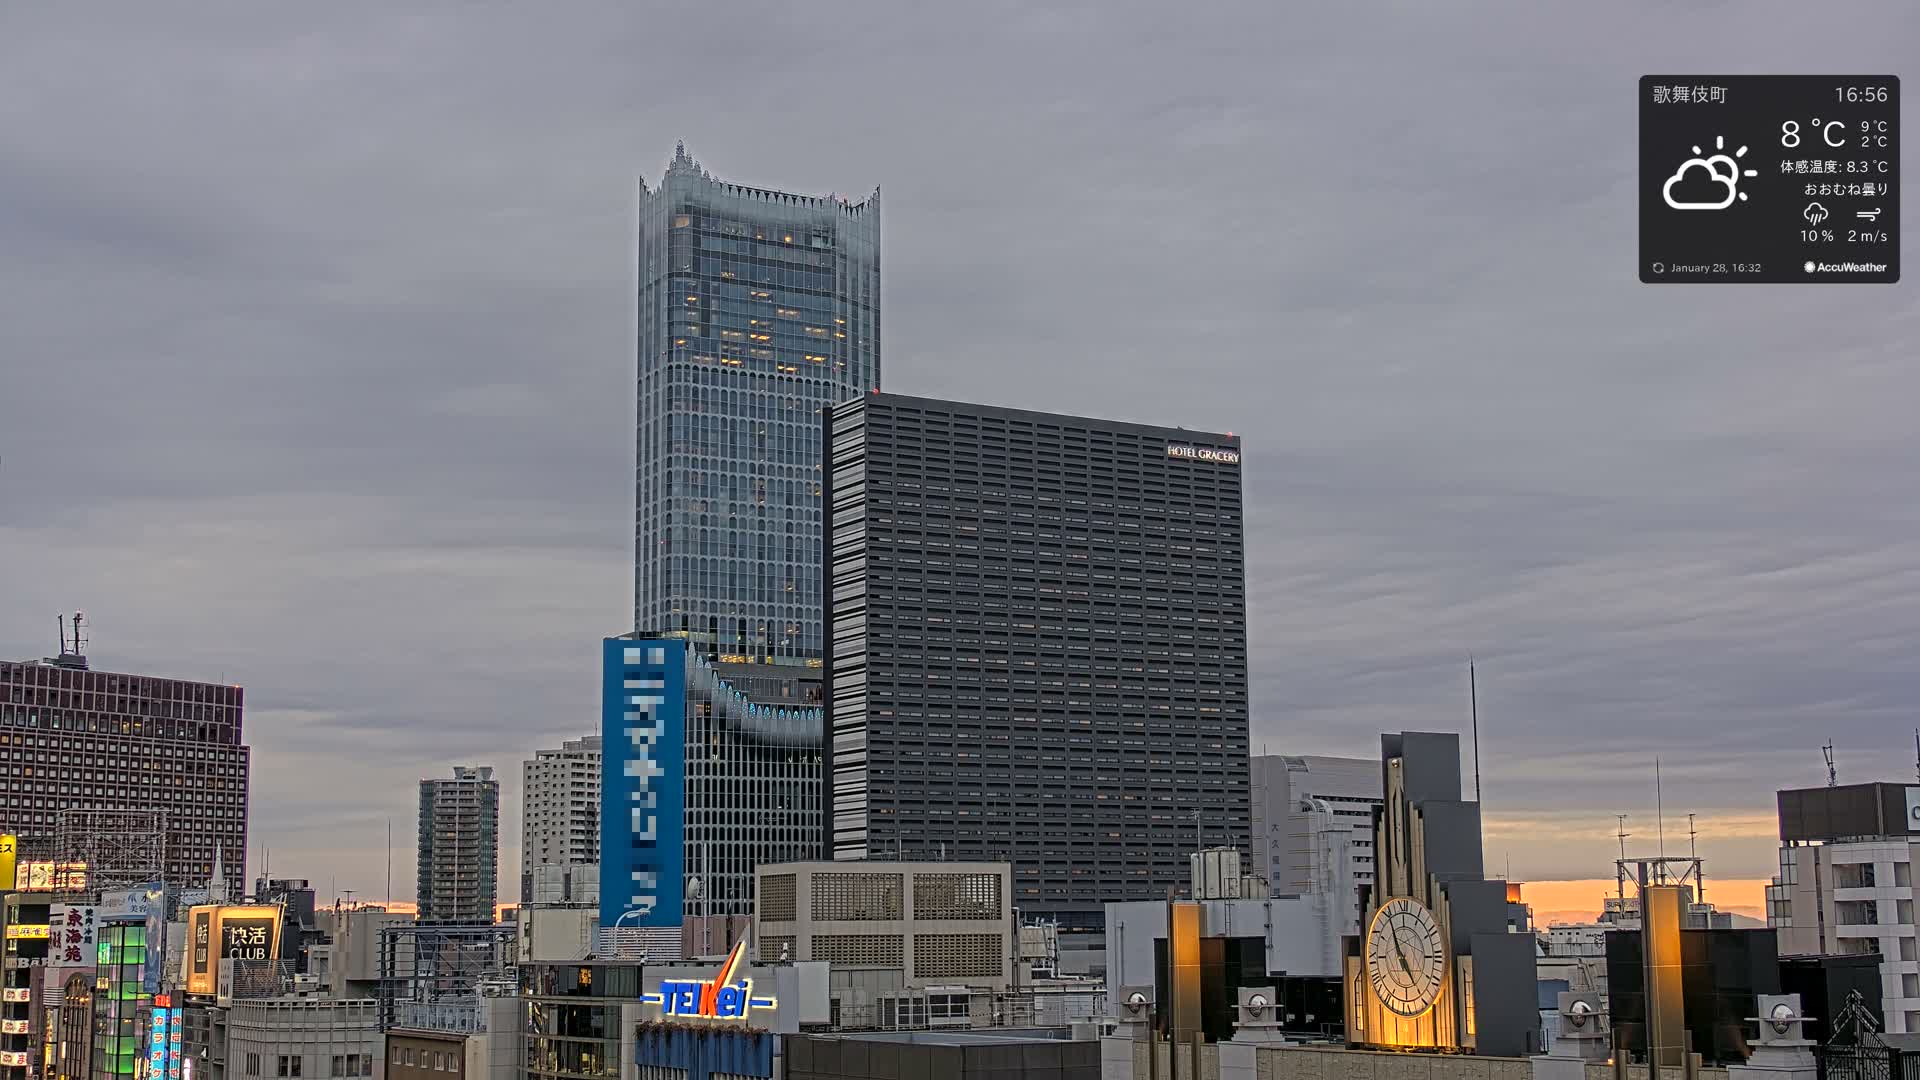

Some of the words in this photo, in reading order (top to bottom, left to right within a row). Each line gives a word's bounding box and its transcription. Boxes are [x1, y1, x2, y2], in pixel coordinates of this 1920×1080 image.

[1168, 446, 1197, 458] HOTEL
[1199, 449, 1239, 463] GRACERY
[231, 927, 266, 945] 快活
[230, 947, 265, 960] CLUB
[153, 1016, 164, 1079] カラオケ
